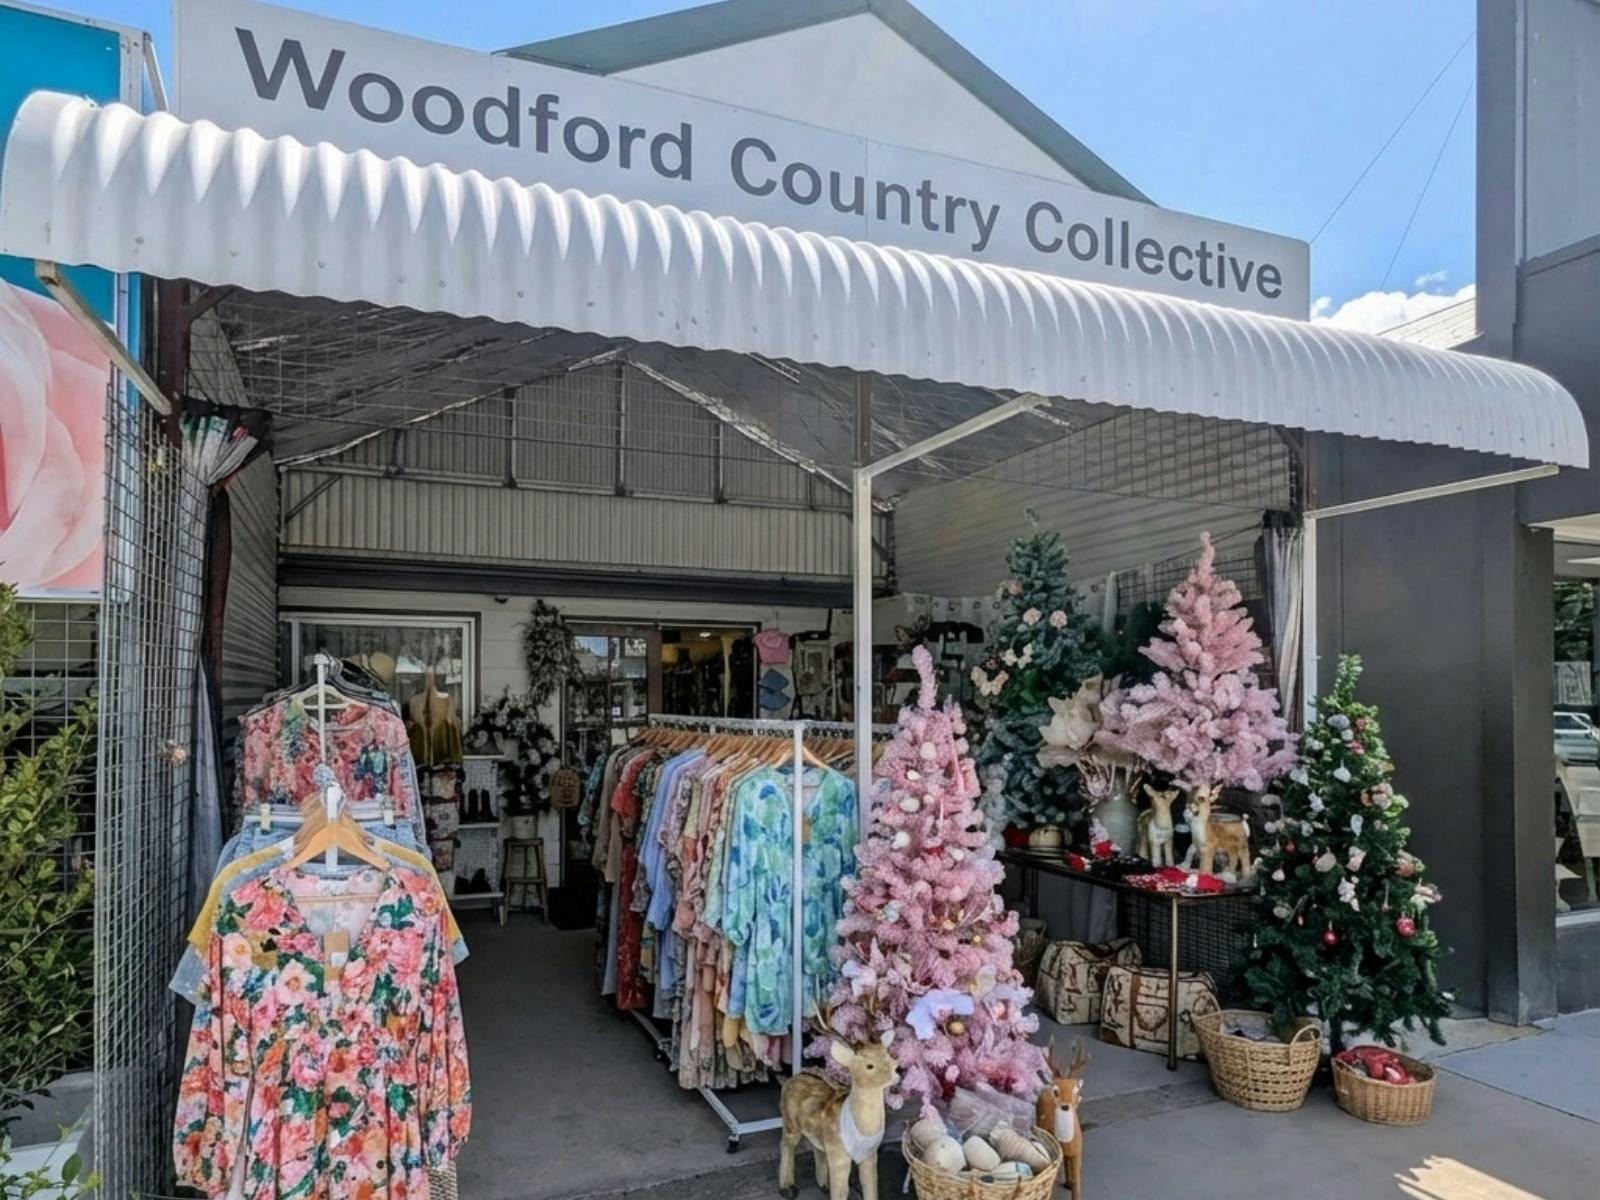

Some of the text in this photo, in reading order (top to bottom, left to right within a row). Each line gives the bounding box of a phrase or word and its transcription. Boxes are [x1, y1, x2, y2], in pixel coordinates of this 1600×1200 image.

[234, 26, 1282, 299] Woodford Country Collective
